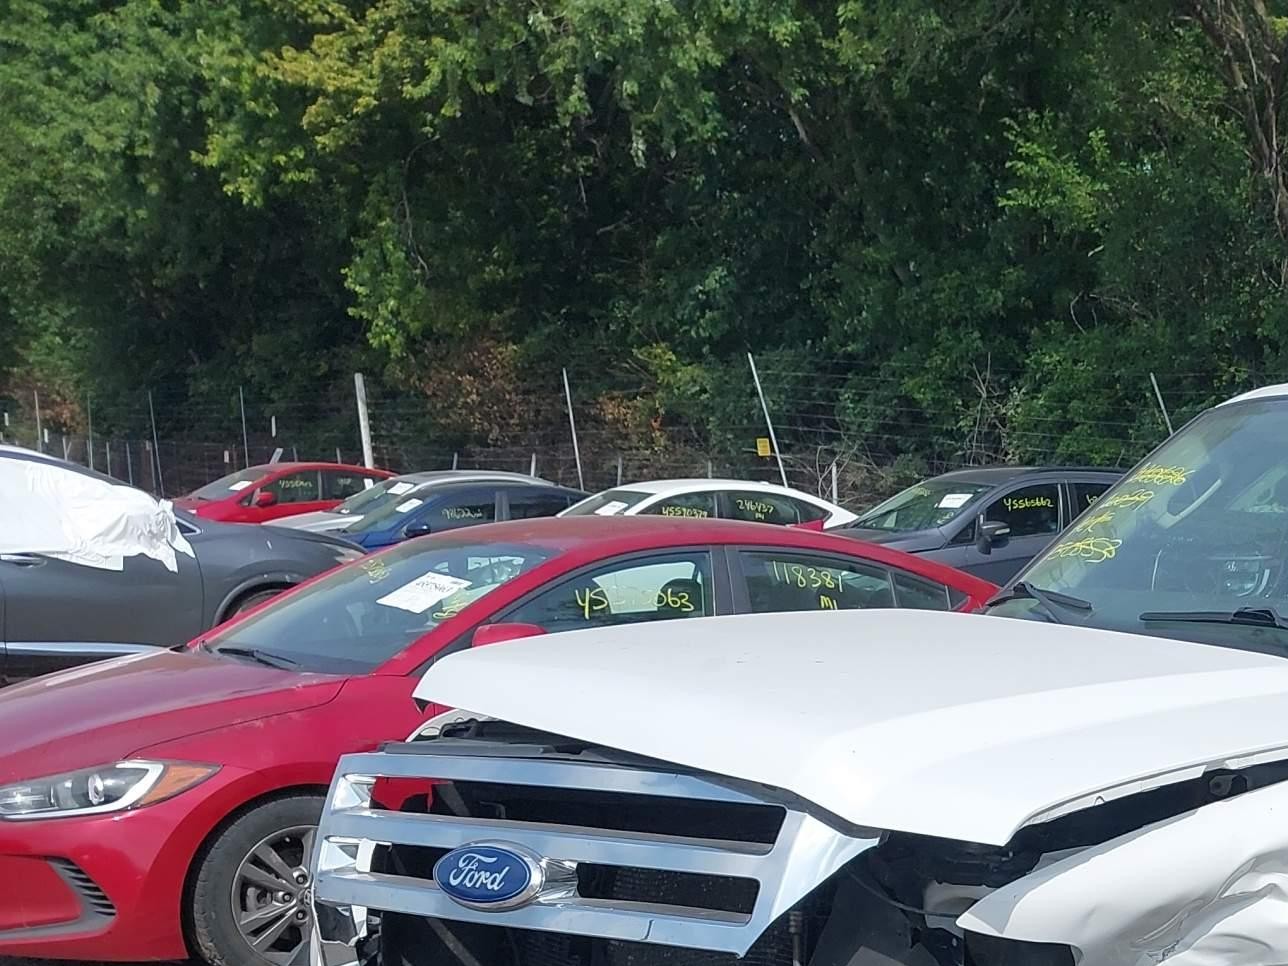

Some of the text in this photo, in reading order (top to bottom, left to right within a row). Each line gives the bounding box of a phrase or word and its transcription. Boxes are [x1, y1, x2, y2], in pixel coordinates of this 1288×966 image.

[1003, 496, 1055, 512] 45565662
[773, 560, 843, 593] 118381
[449, 853, 510, 891] Ford
